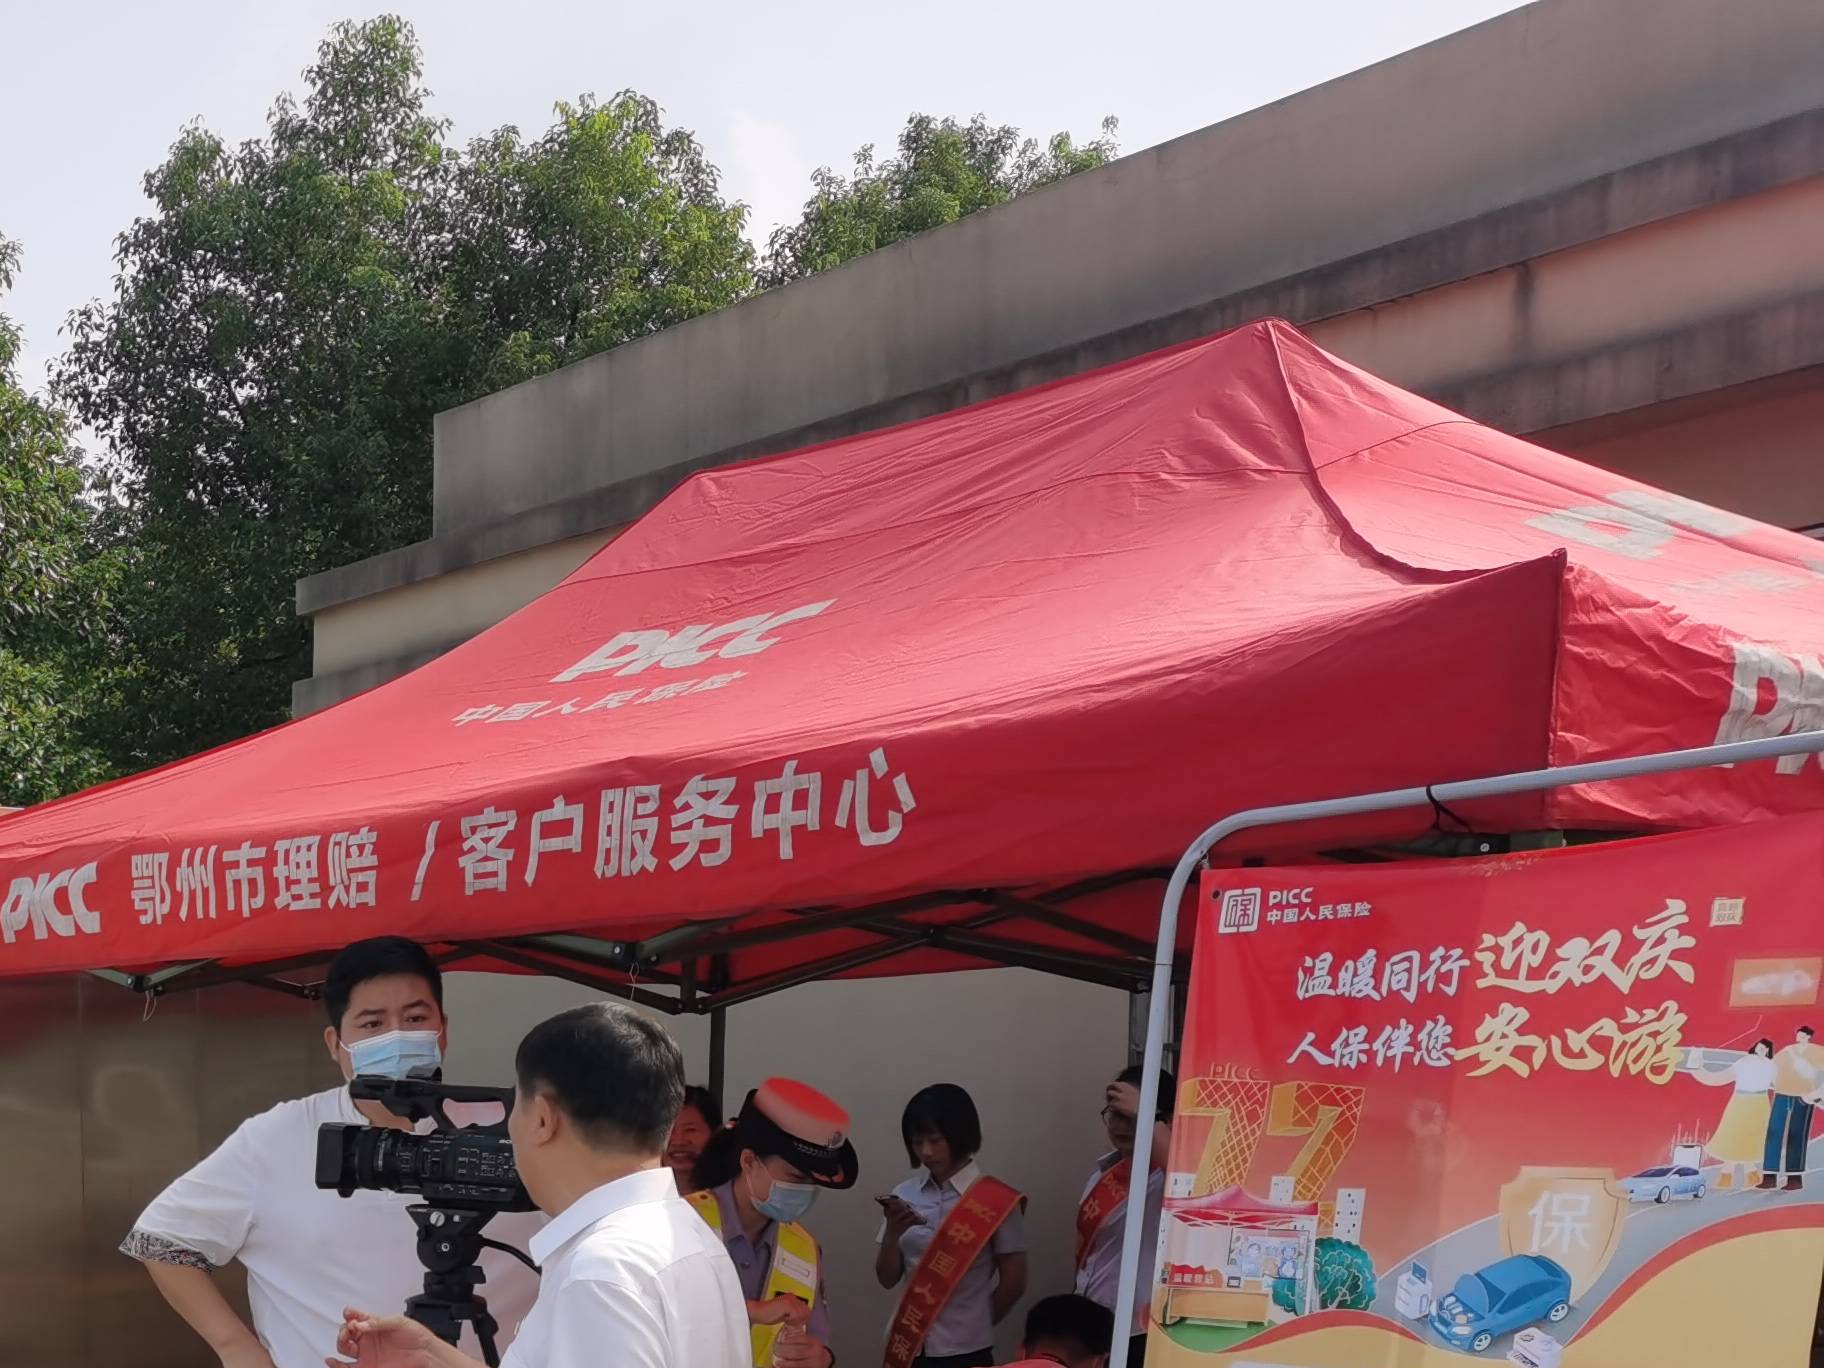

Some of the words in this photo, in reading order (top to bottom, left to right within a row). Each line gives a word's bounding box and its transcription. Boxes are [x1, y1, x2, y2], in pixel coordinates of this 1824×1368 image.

[548, 598, 838, 683] PICC
[0, 860, 102, 944] PICC
[129, 824, 378, 927] 鄂州市理赔
[458, 745, 916, 894] 客户服务中心
[1266, 901, 1372, 925] 中国人民保险
[1269, 887, 1314, 907] PICC
[1296, 946, 1472, 1004] 温暖同行
[1474, 898, 1697, 995] 迎双庆
[1286, 1014, 1460, 1074] 人保伴您
[1453, 1001, 1688, 1085] 安心游
[1527, 1193, 1597, 1255] 保
